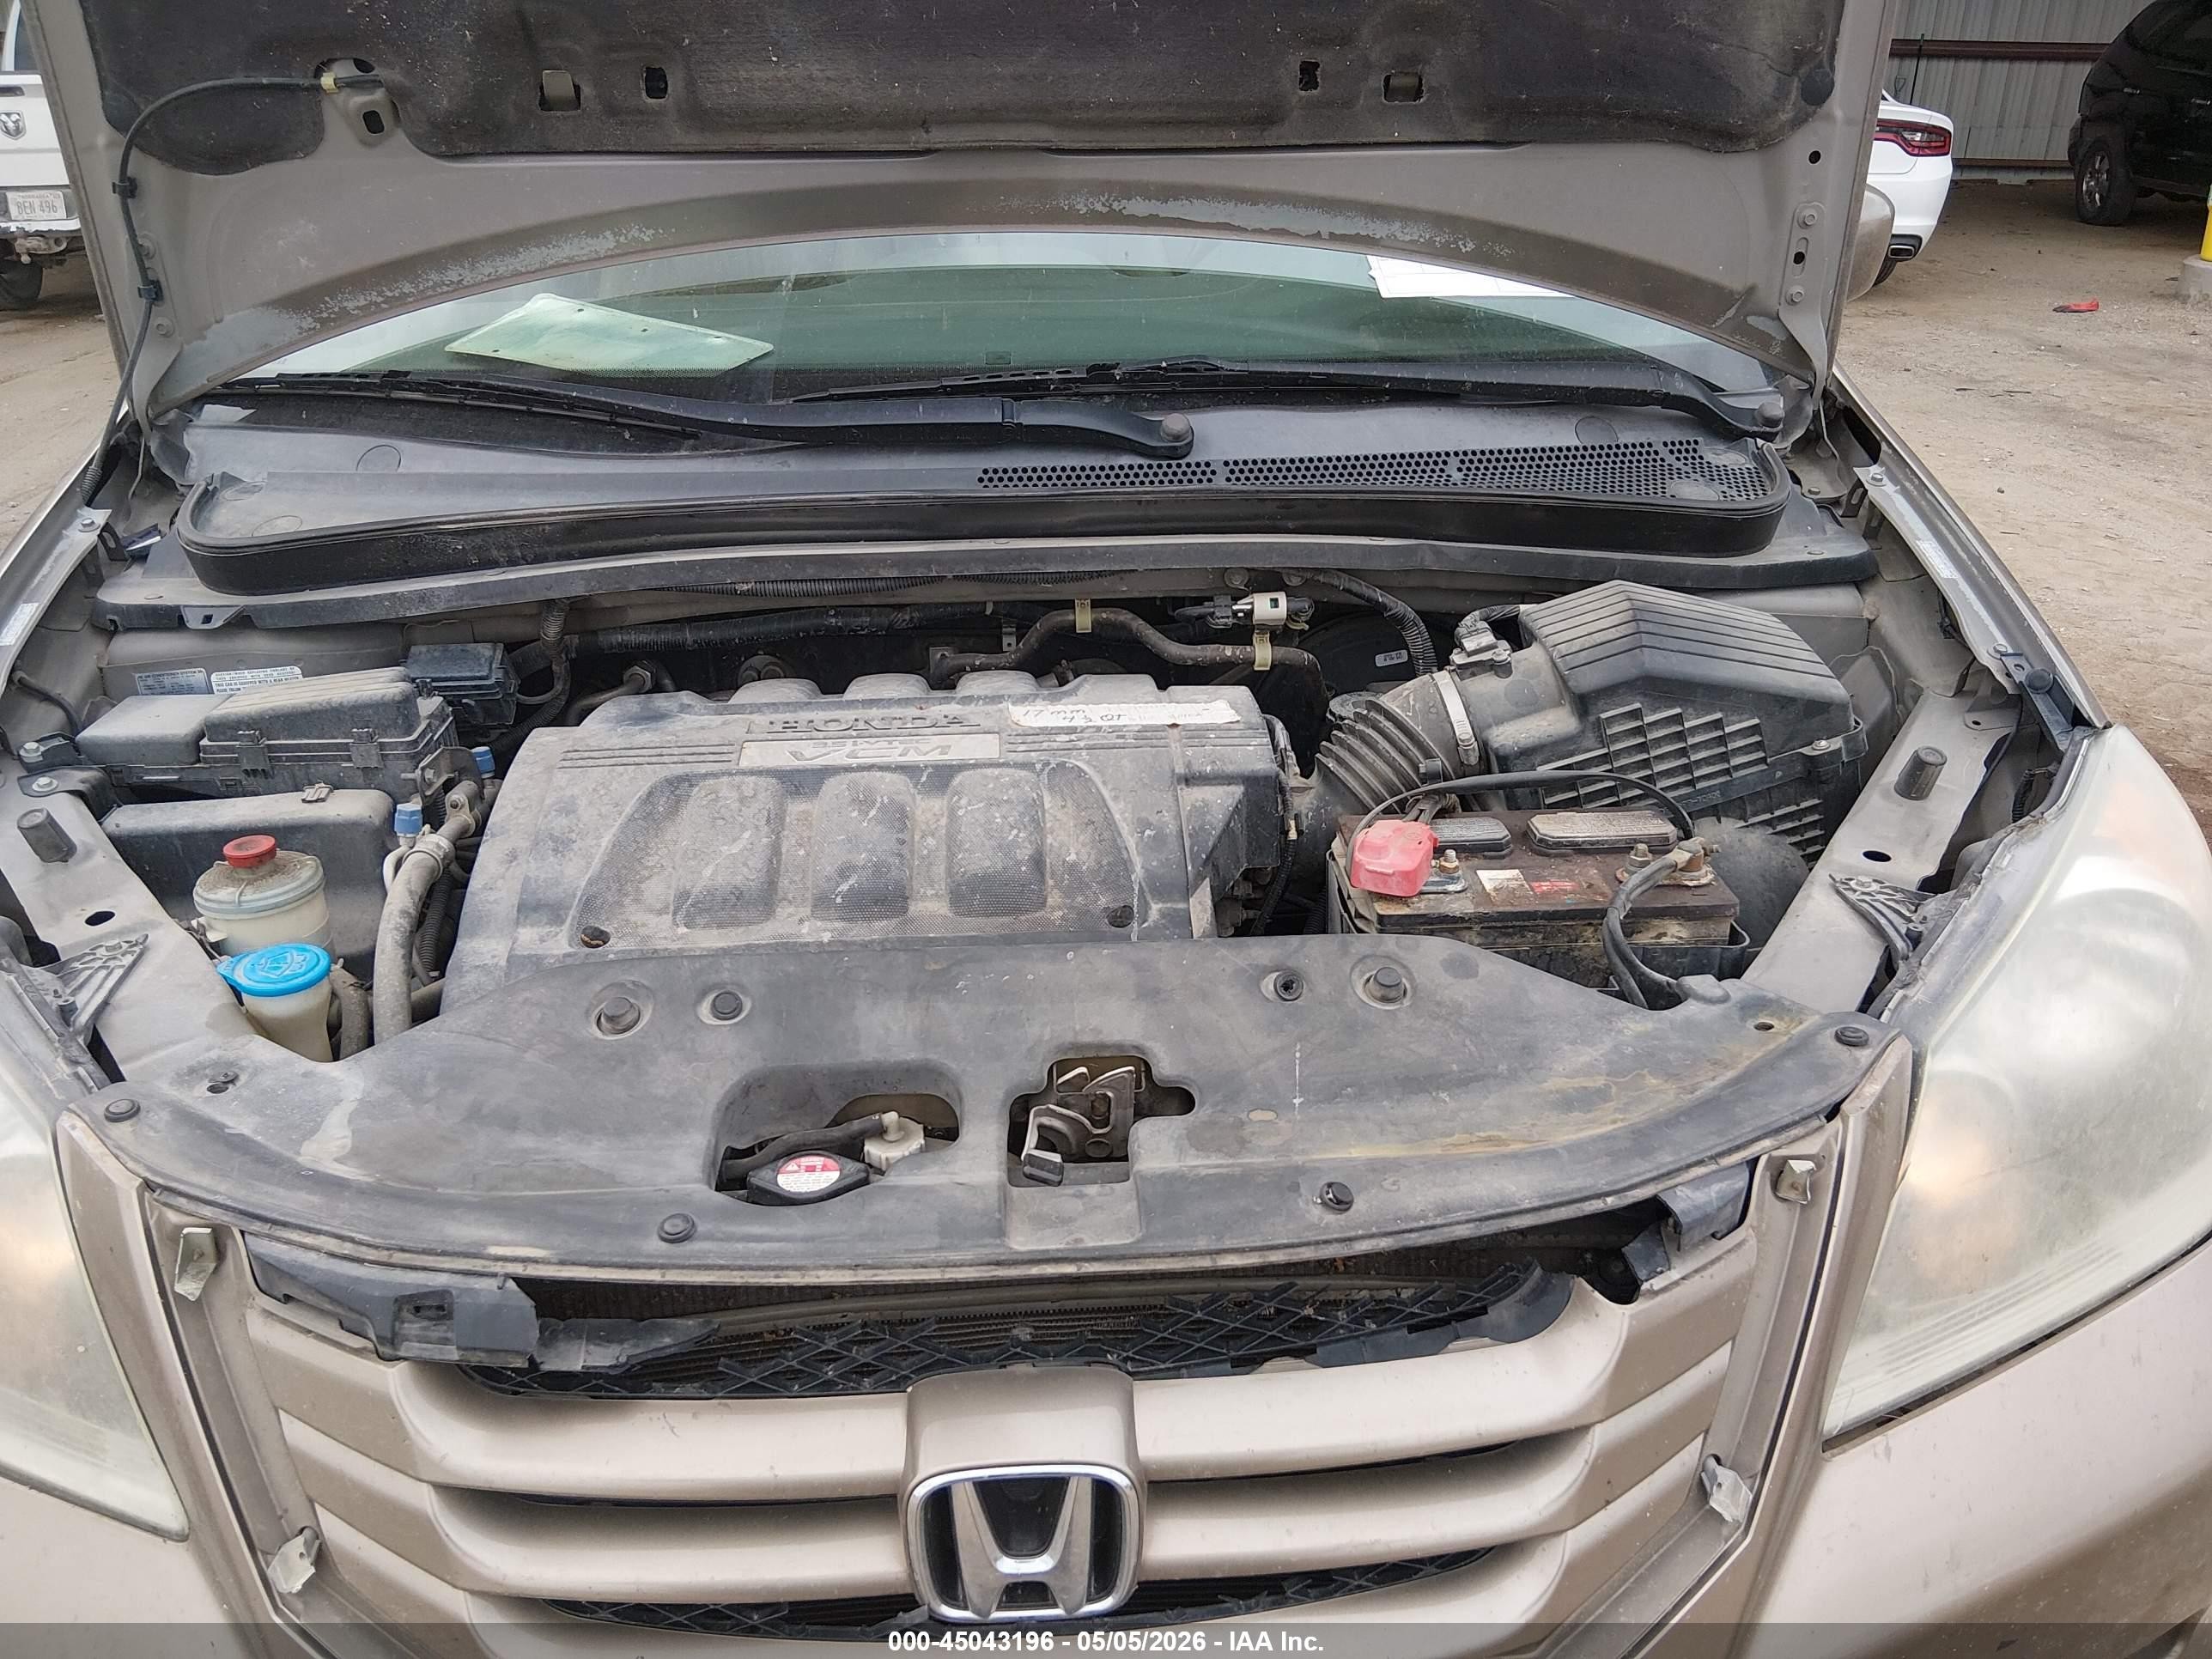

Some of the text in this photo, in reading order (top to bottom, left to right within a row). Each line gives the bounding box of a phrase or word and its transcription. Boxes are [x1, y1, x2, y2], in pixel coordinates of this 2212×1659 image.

[38, 199, 58, 214] 496
[766, 714, 981, 733] HONDA
[785, 742, 953, 763] VCM
